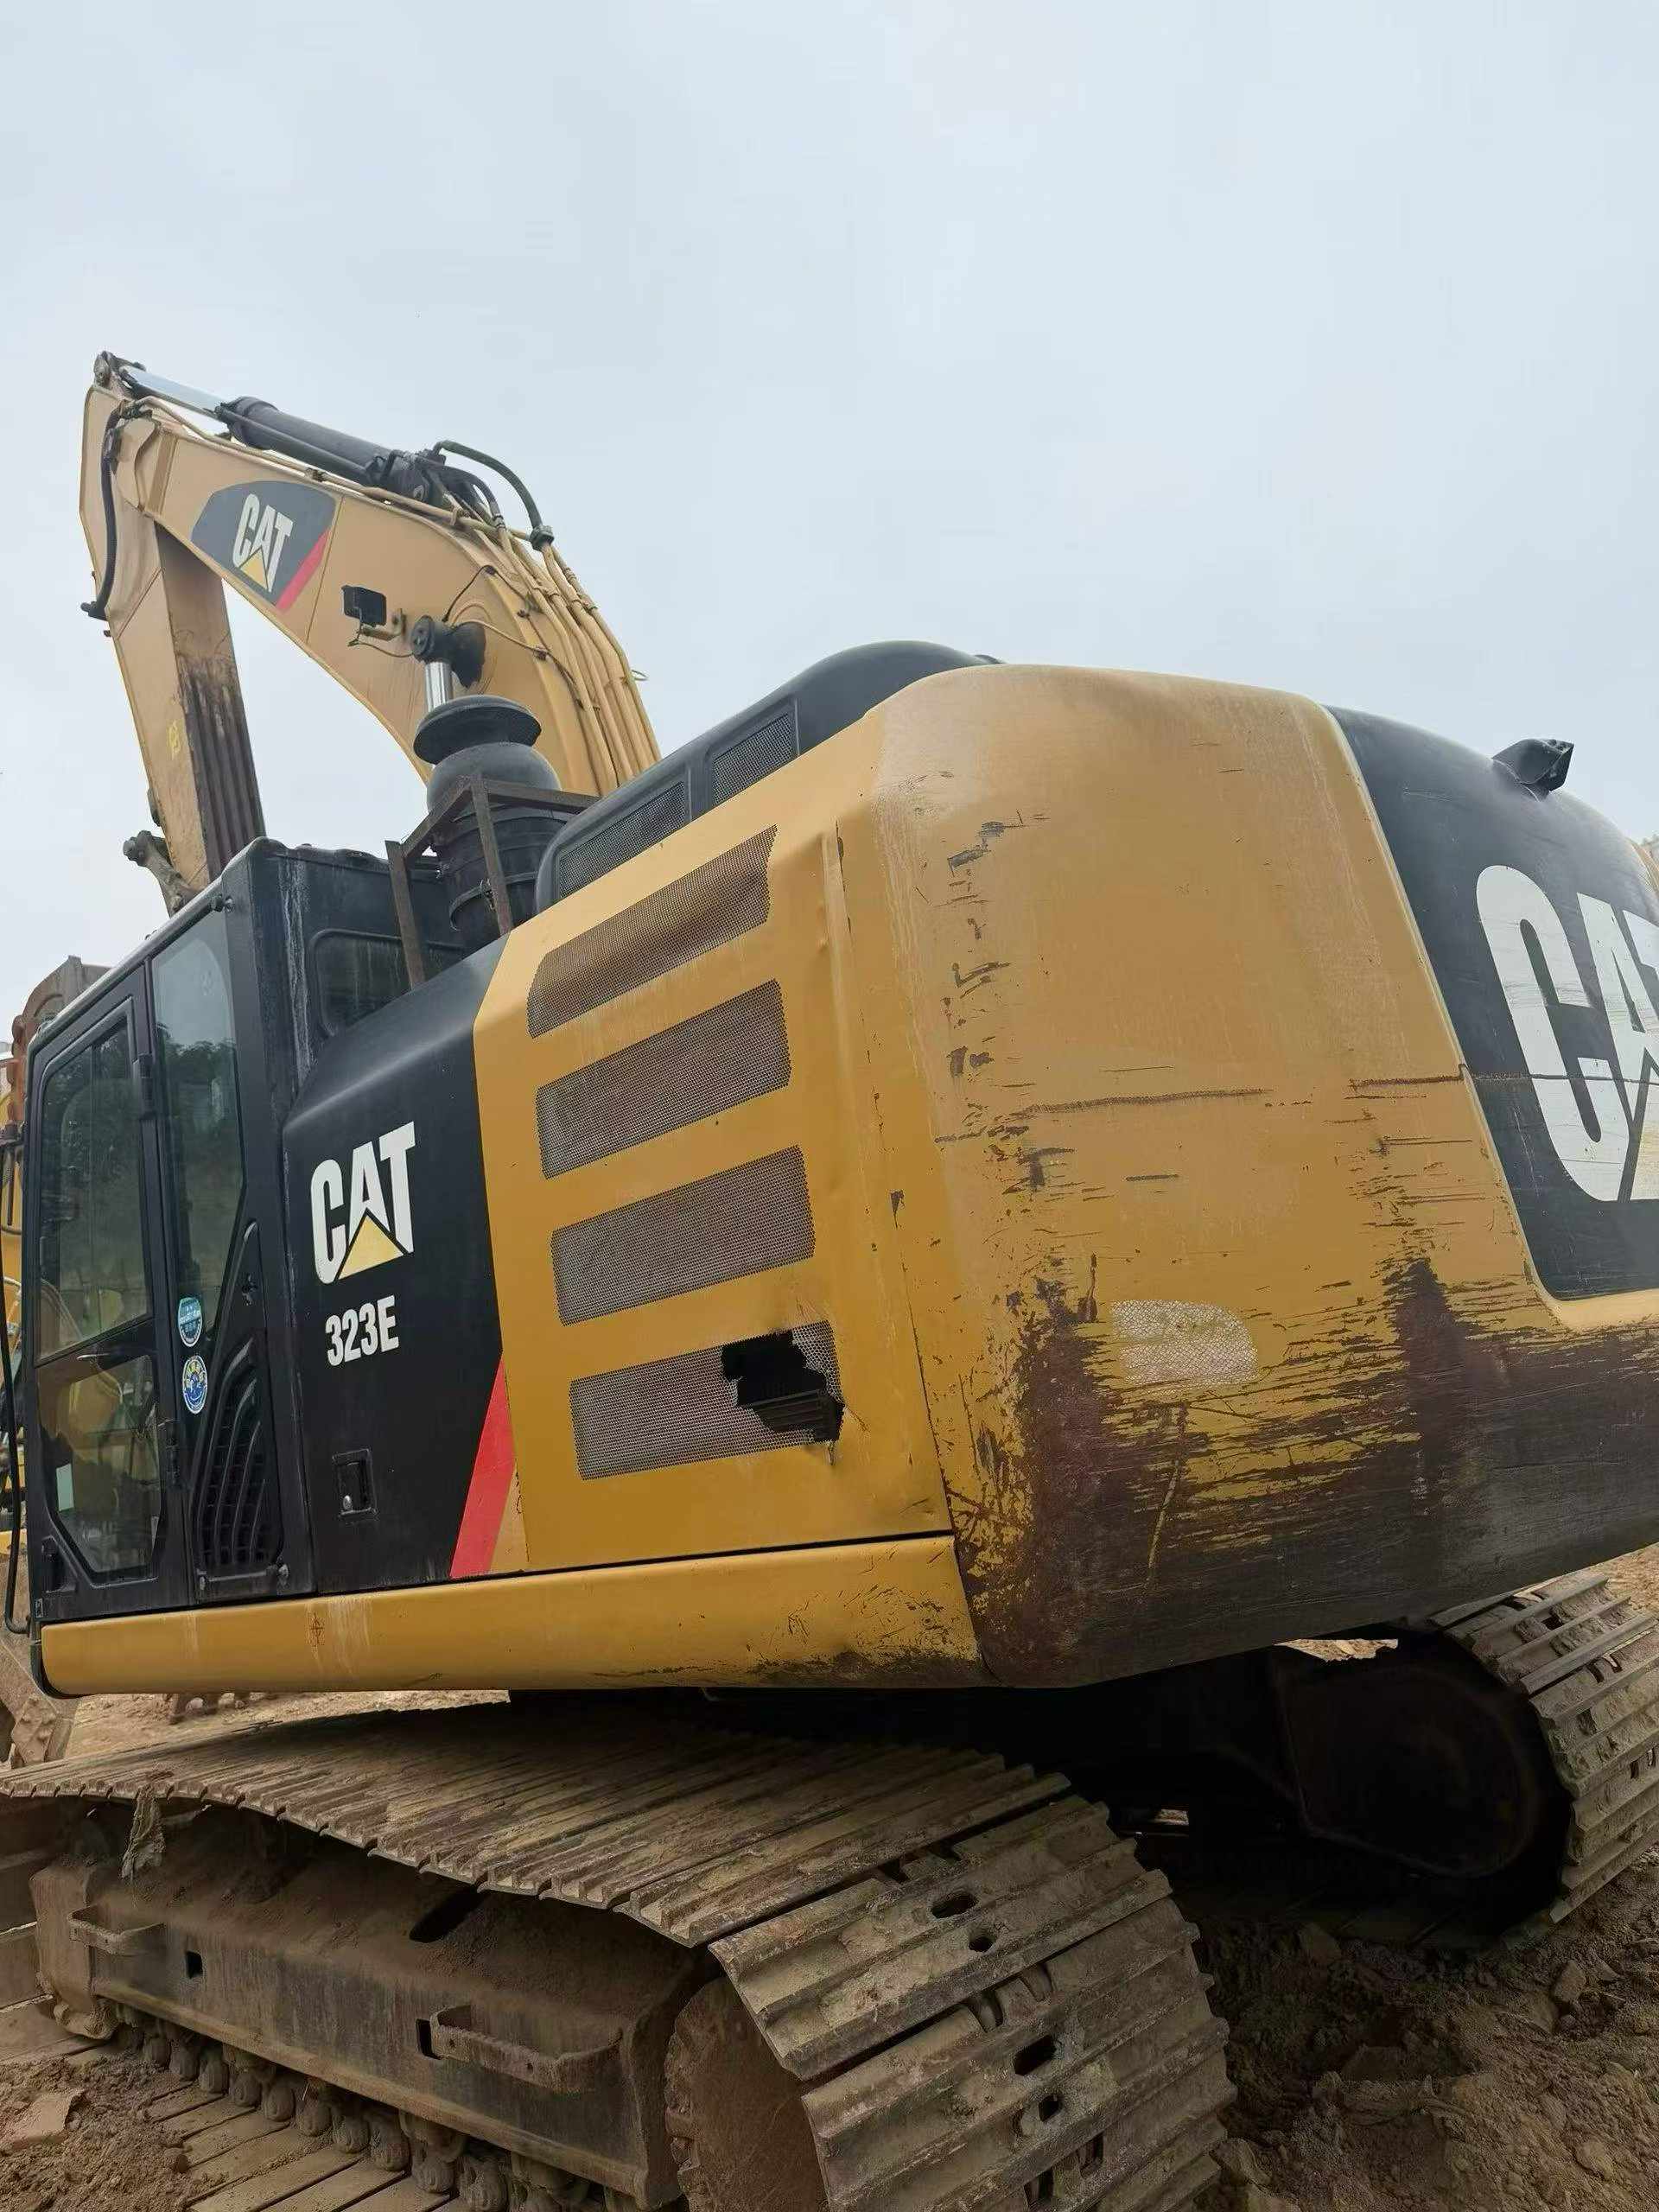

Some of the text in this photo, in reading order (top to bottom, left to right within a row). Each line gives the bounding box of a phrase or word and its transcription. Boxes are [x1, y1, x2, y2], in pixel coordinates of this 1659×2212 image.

[232, 493, 294, 593] CAT
[1476, 865, 1659, 1202] CA
[310, 1121, 416, 1284] CAT
[325, 1295, 399, 1366] 323E
